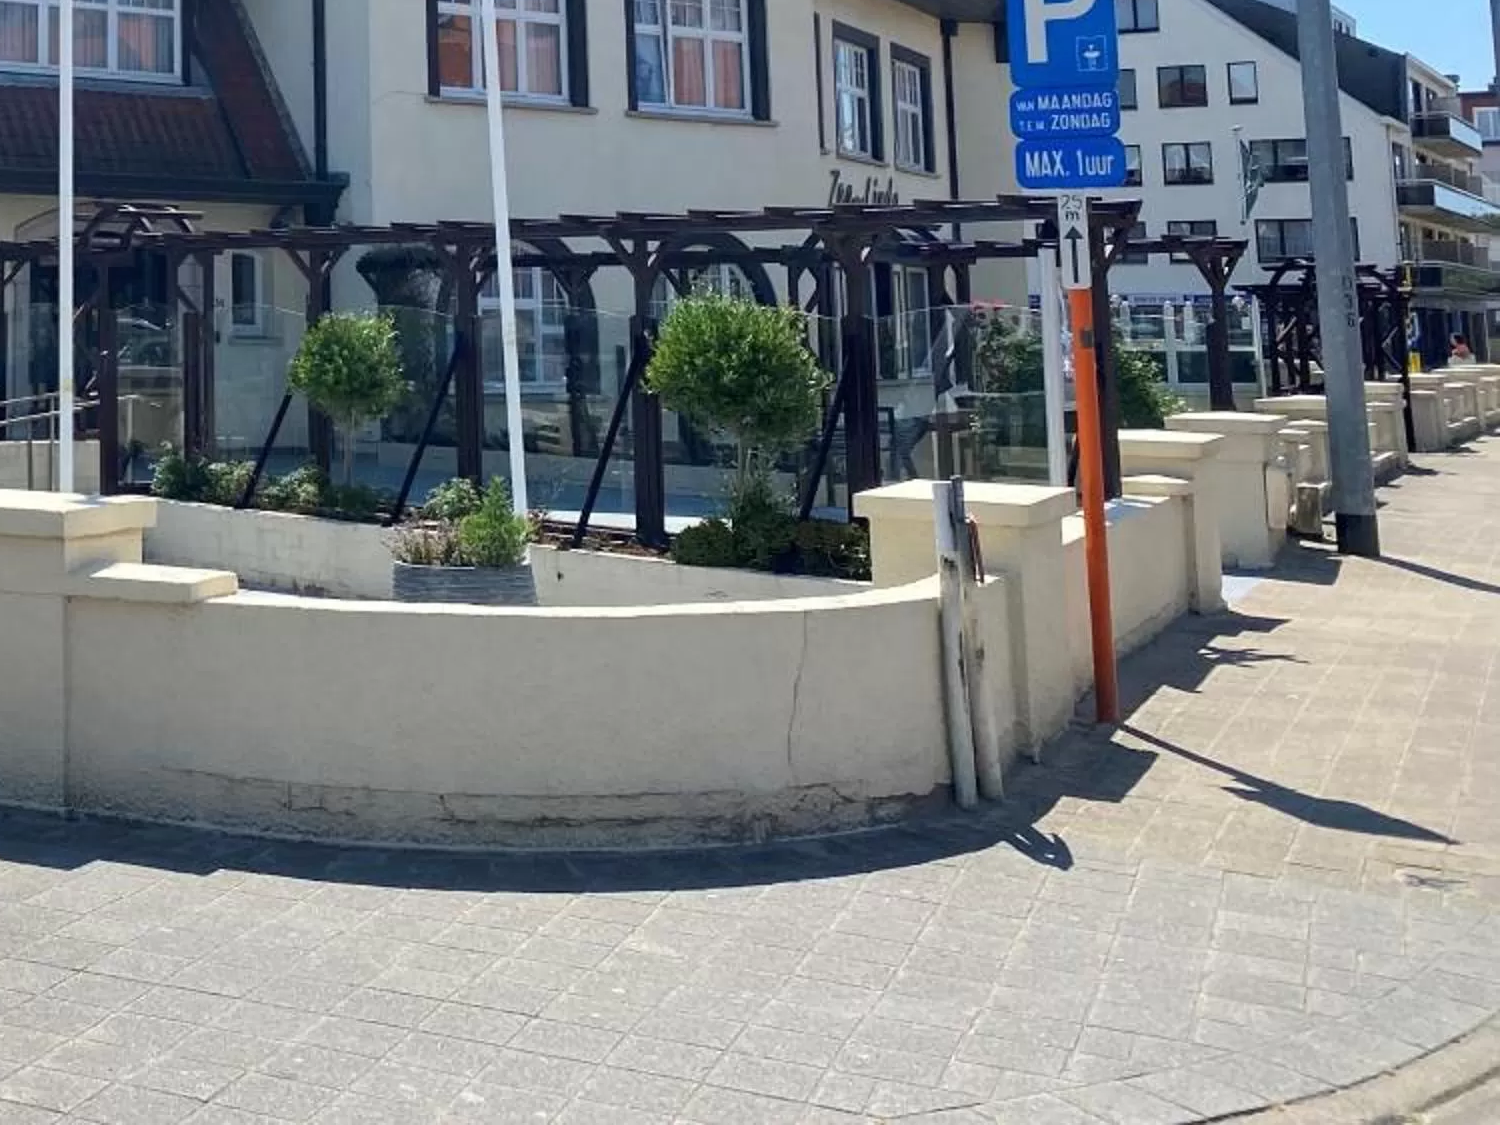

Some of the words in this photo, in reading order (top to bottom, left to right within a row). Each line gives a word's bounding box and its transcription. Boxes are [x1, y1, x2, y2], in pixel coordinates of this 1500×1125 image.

[1038, 92, 1112, 110] MAANDAG
[1051, 112, 1110, 130] ZONDAG
[1025, 150, 1071, 178] MAX.
[1060, 194, 1082, 210] 25
[1065, 211, 1080, 221] m
